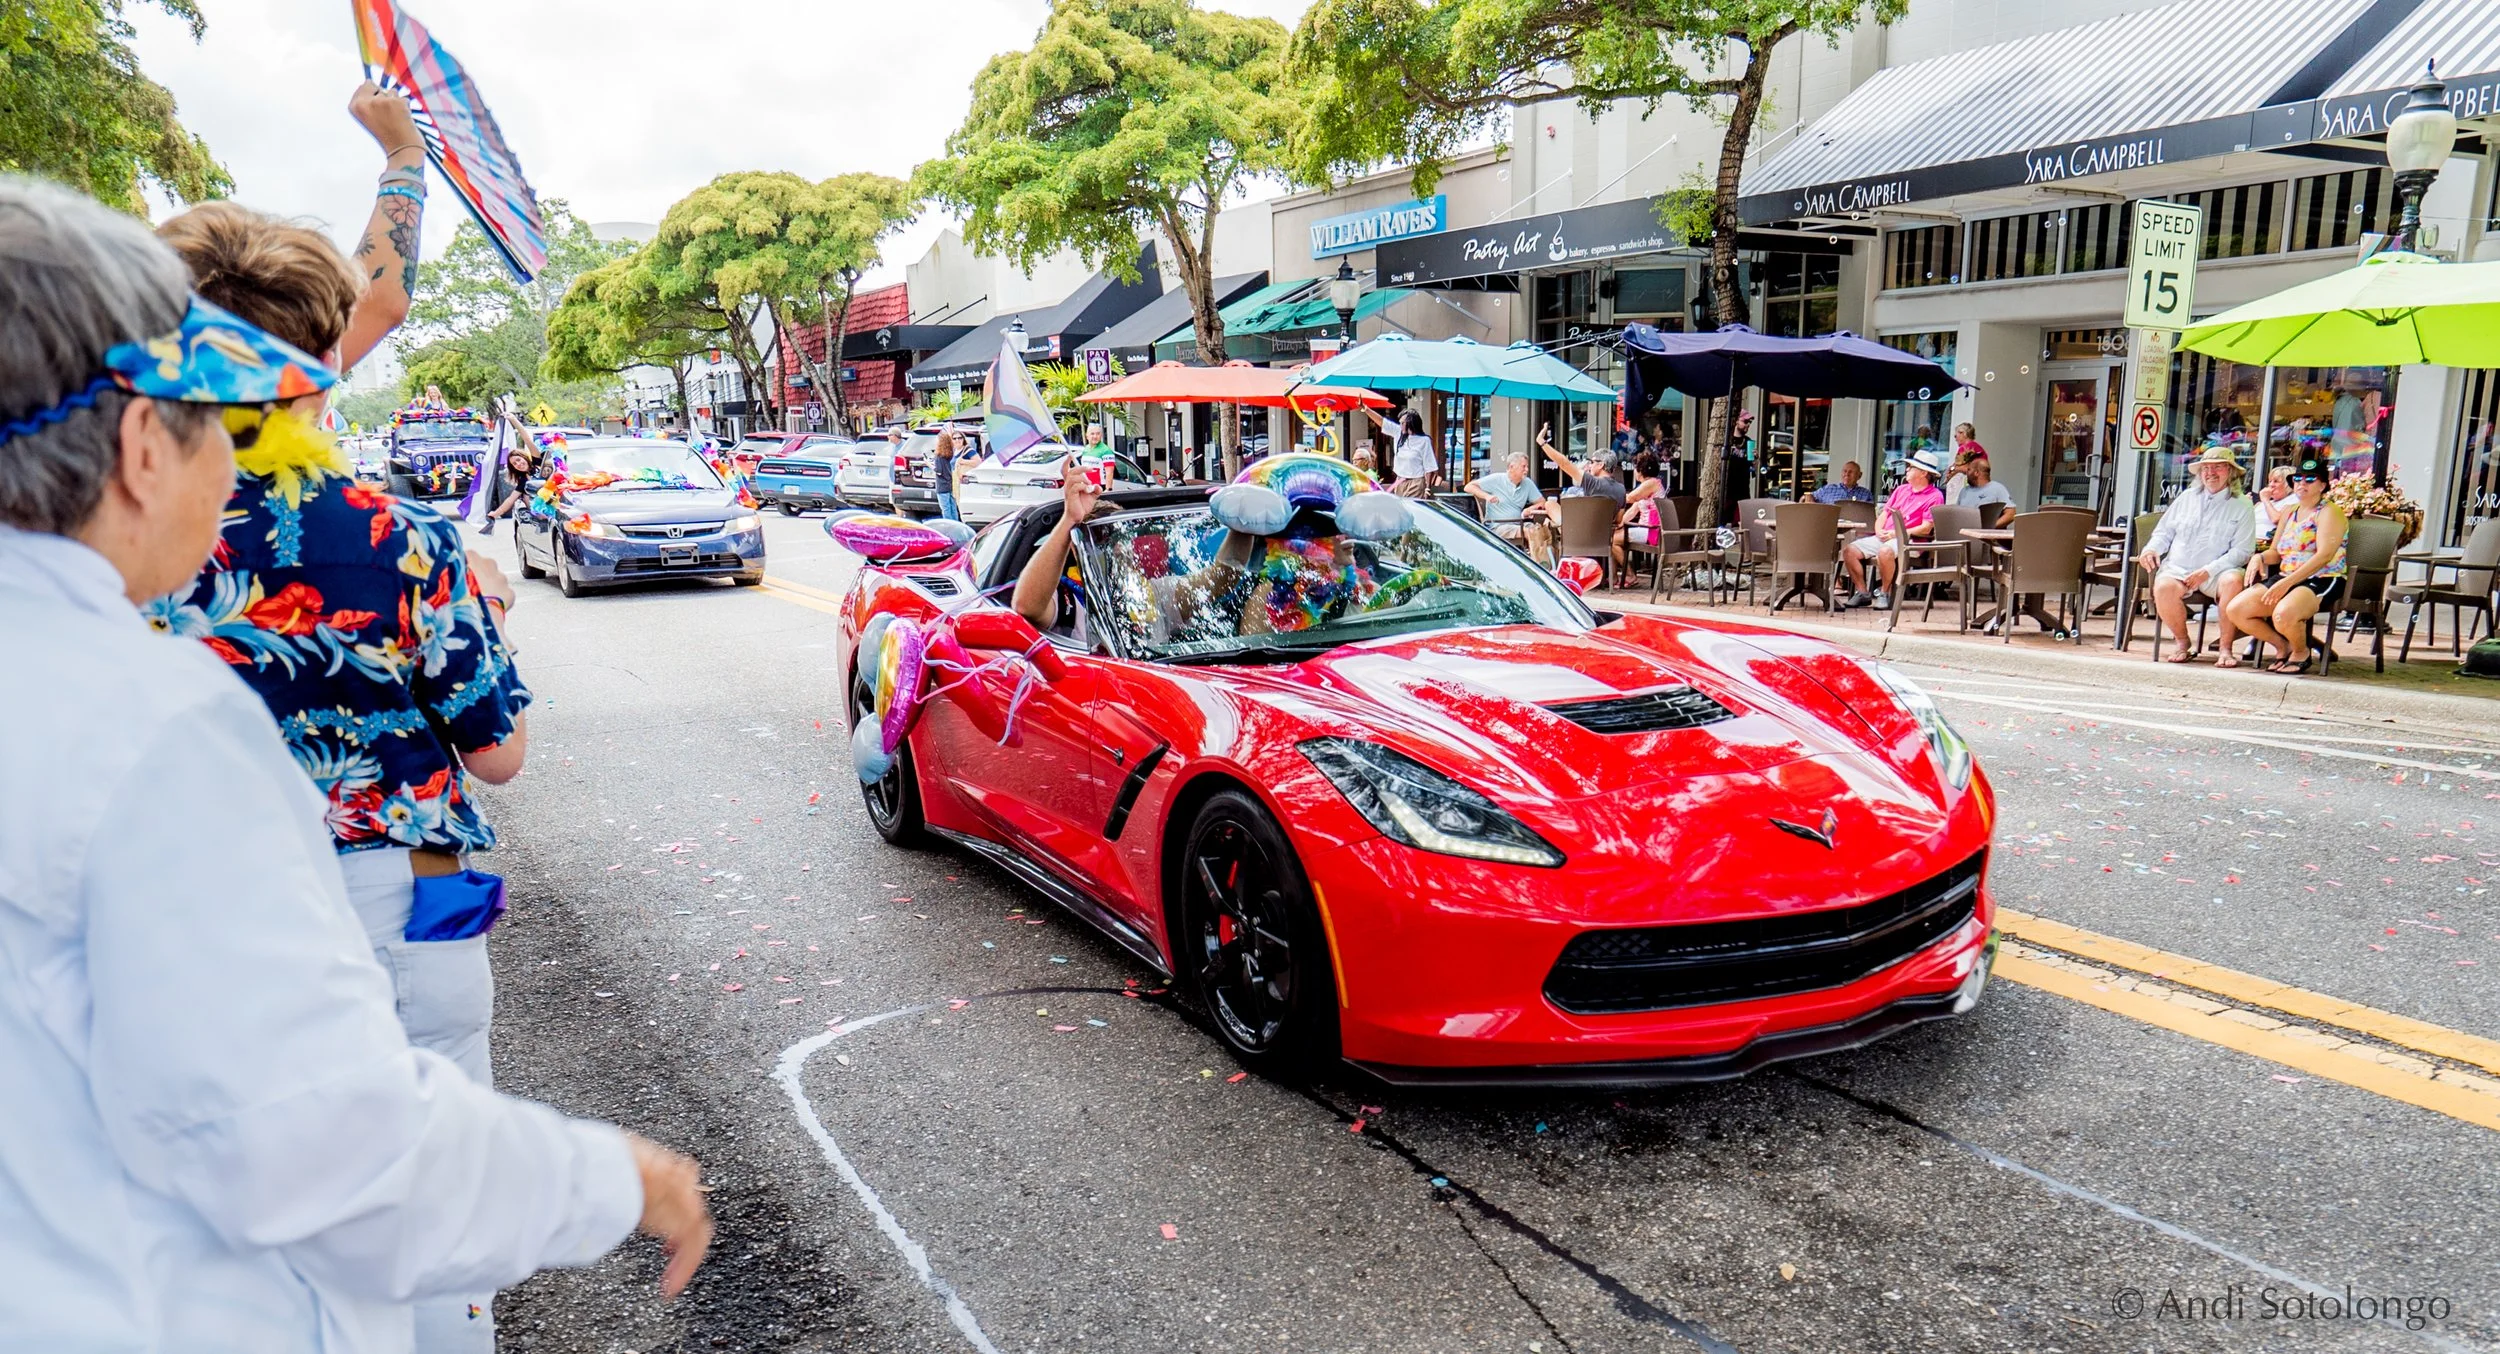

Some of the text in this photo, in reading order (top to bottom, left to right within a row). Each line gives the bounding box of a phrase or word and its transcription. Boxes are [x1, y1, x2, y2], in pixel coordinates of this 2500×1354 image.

[2319, 98, 2375, 139] SARA
[2024, 138, 2164, 184] SARA CAMPBELL
[1804, 180, 1911, 217] SARA CAMPBELL
[1310, 205, 1438, 251] WILLIAM RAVEIS
[2141, 212, 2195, 235] SPEED
[1463, 231, 1542, 270] Pastry Art
[1618, 238, 1647, 251] sandwich
[2144, 238, 2186, 260] LIMIT
[1390, 273, 1403, 283] Since
[2143, 269, 2179, 315] 15
[2144, 345, 2165, 354] LOADING
[2150, 335, 2161, 343] NO
[1089, 350, 1106, 358] PAY
[1088, 374, 1110, 382] HERE
